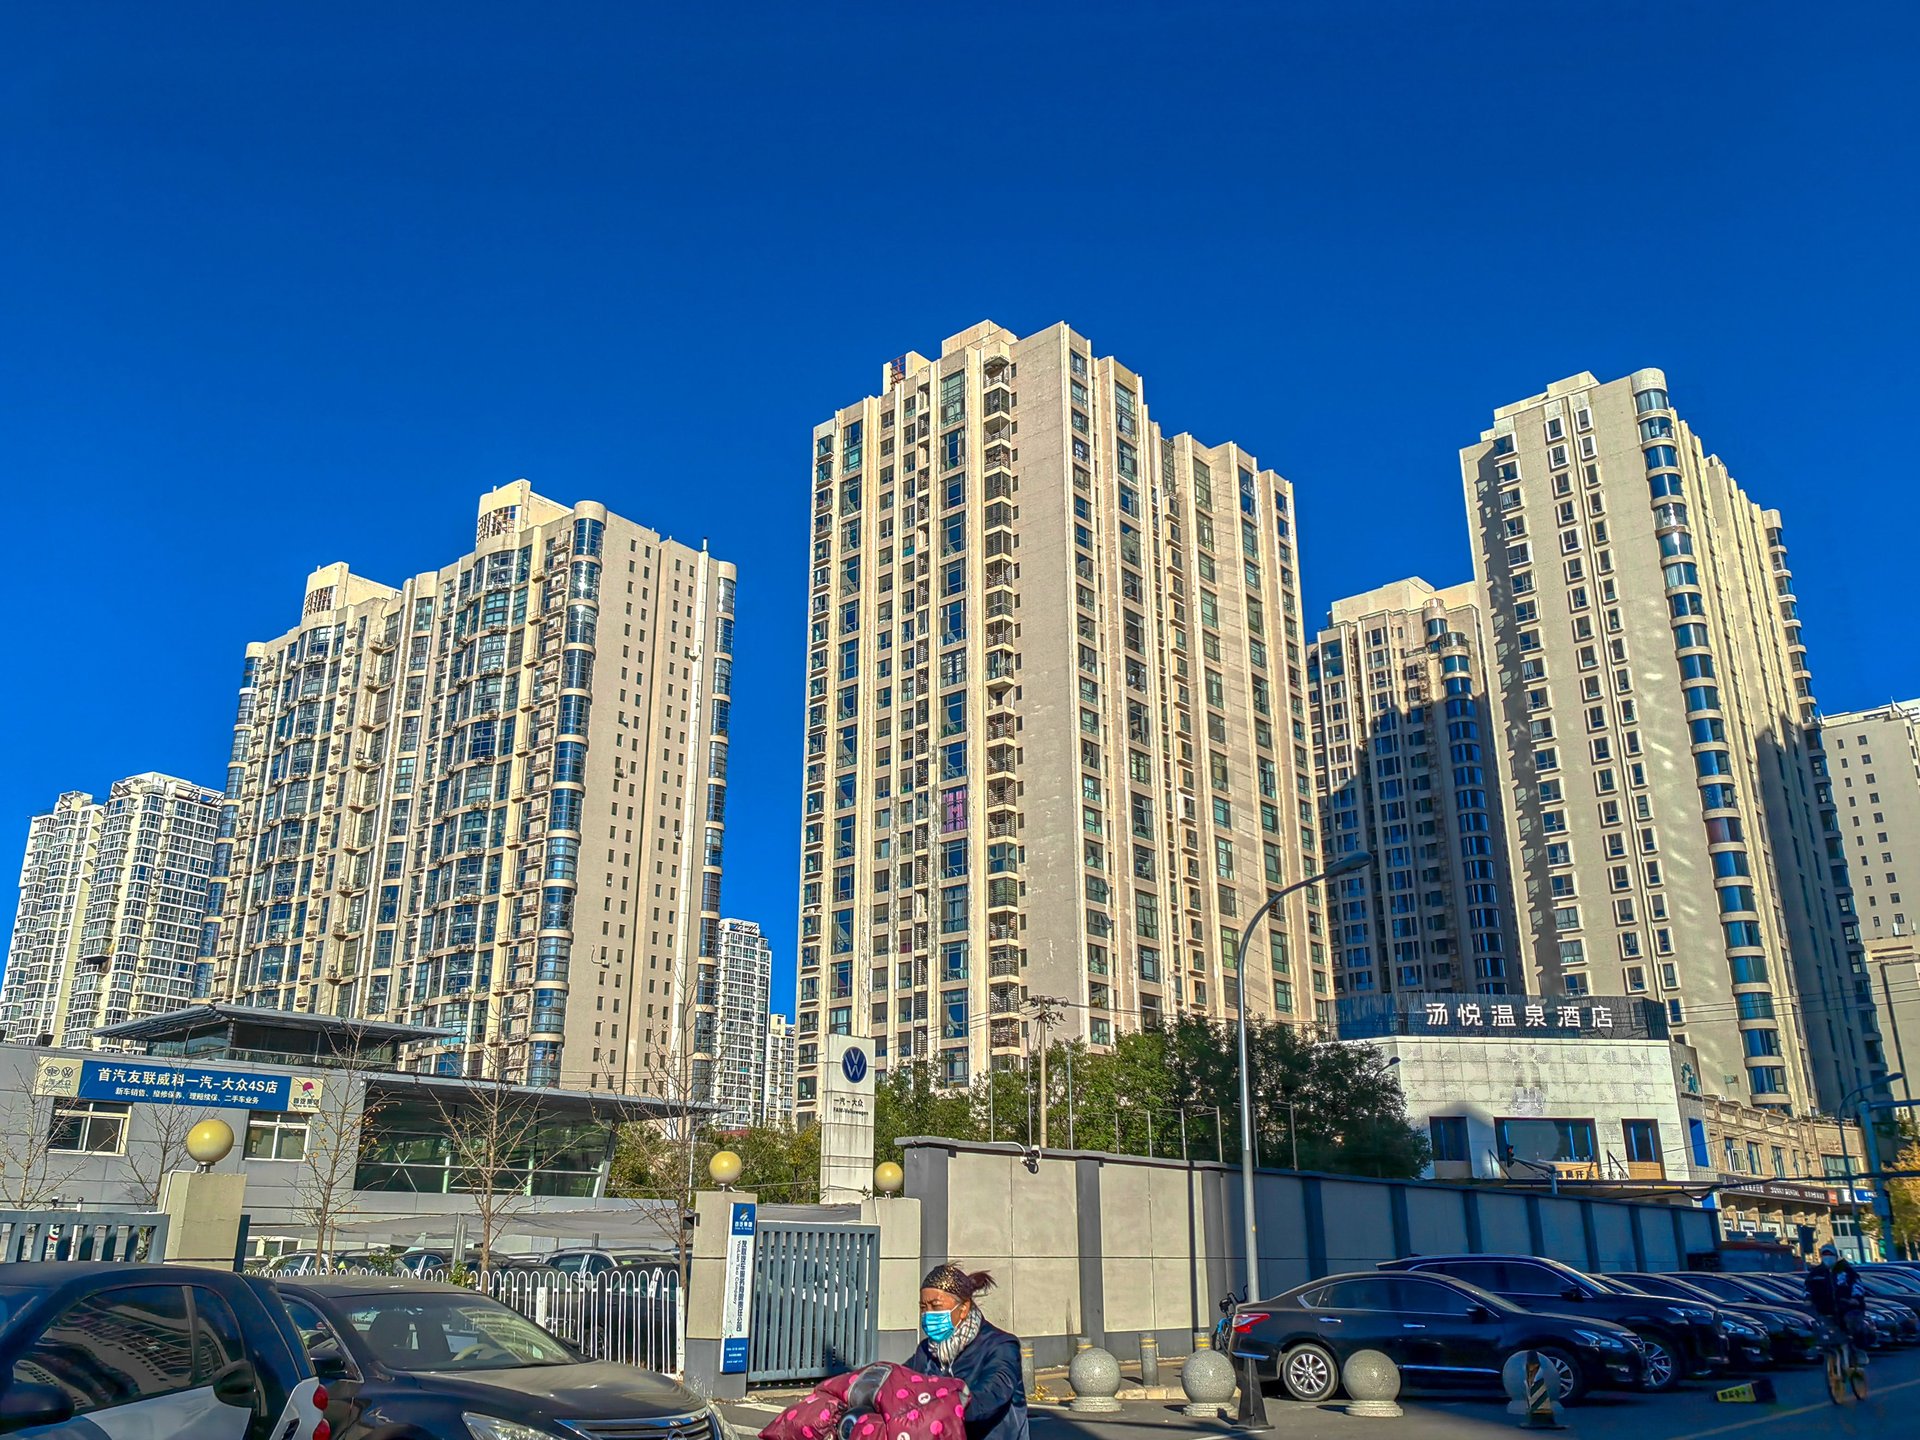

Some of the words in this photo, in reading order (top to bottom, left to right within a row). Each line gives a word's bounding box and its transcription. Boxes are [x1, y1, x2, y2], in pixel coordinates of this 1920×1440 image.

[1425, 1003, 1613, 1028] 汤悦温泉酒店
